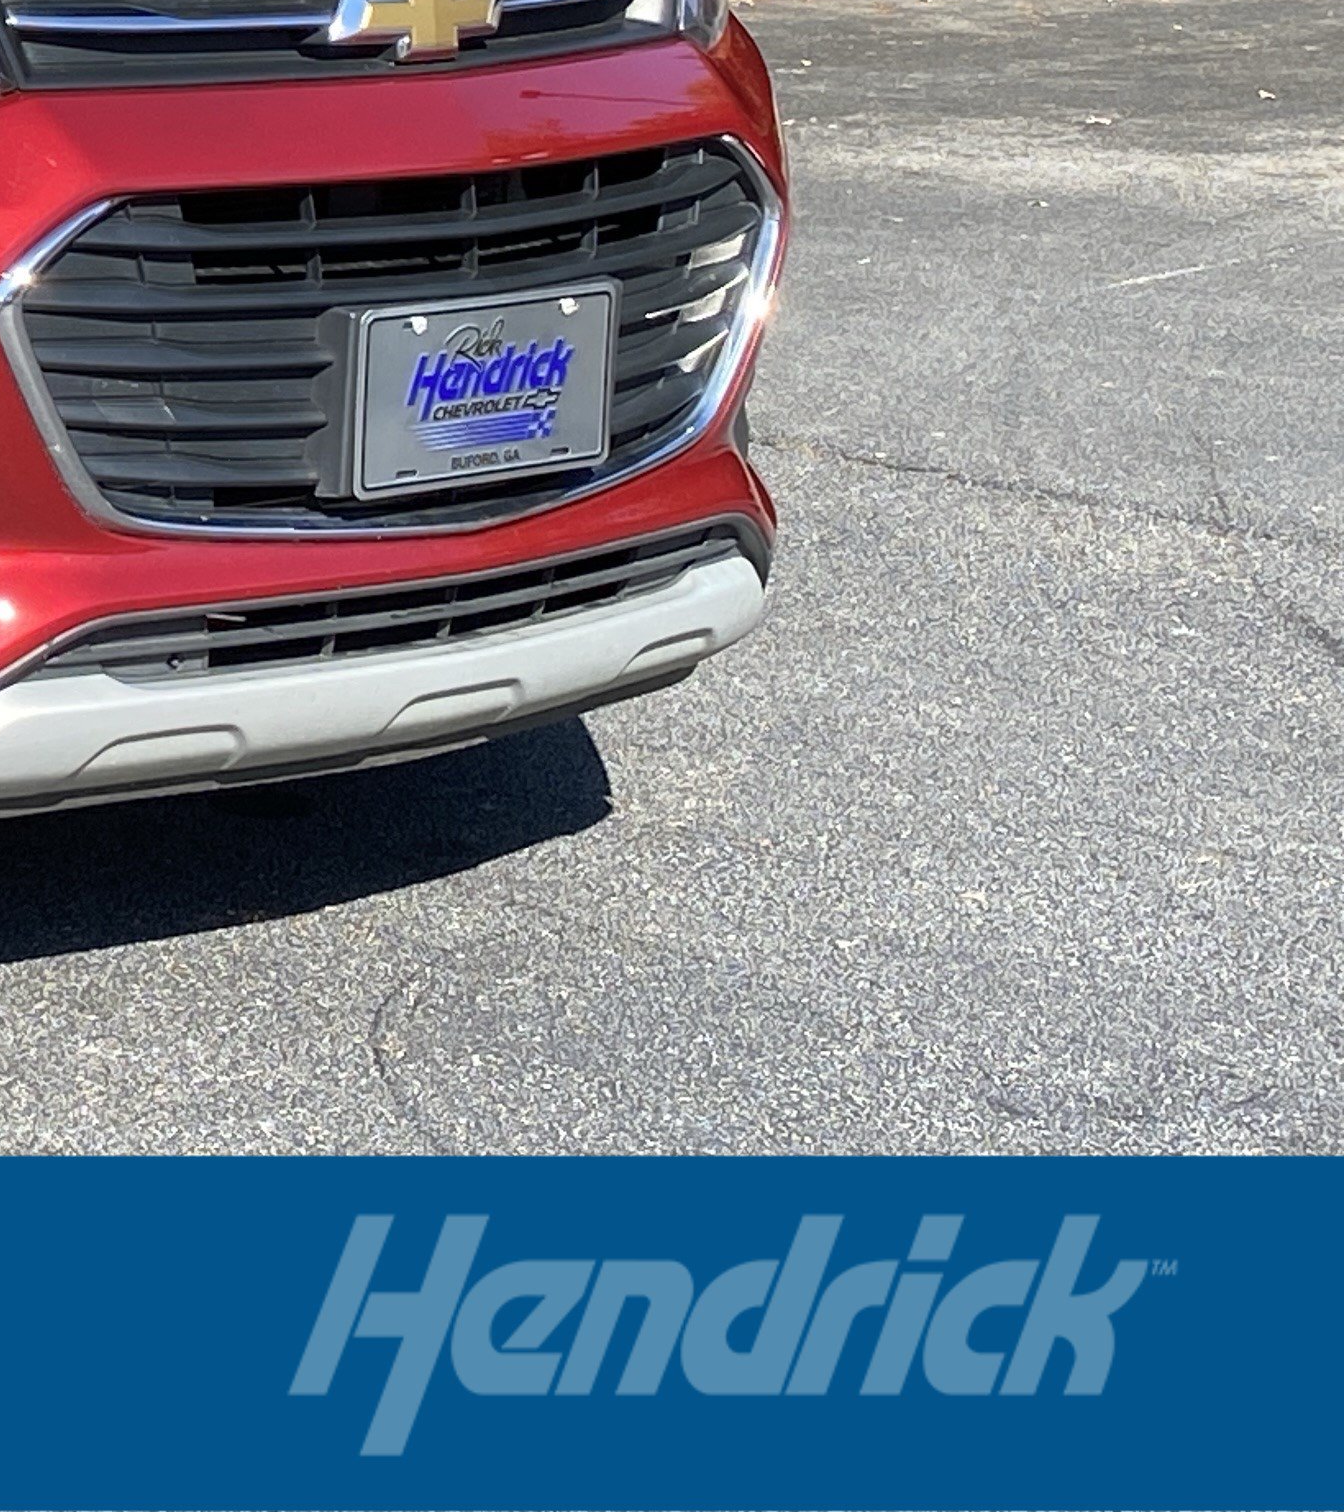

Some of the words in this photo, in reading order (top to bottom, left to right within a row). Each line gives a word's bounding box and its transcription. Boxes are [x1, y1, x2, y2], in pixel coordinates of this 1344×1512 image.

[445, 316, 504, 369] Rick
[406, 338, 575, 422] Hendrick
[432, 394, 524, 421] CHEVROLET
[503, 448, 521, 462] GA
